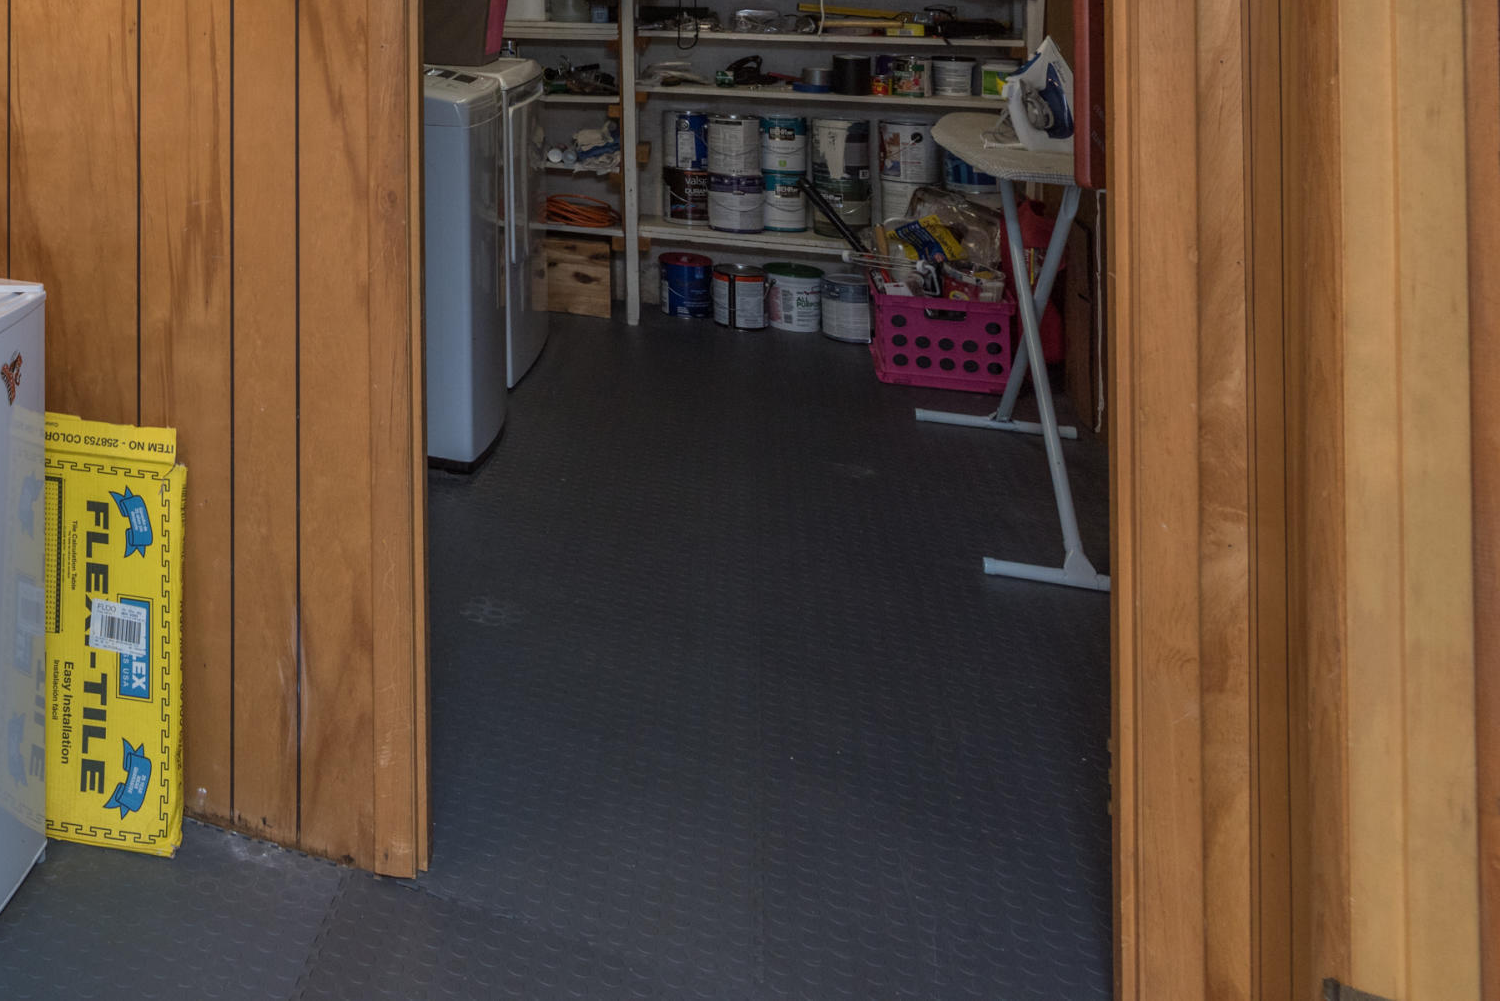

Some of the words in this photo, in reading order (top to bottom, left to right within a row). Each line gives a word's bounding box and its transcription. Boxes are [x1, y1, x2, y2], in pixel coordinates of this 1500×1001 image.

[45, 431, 81, 444] COLOR
[84, 436, 119, 447] 258753
[128, 440, 145, 450] NO
[148, 442, 174, 454] ITEM
[62, 660, 75, 691] Easy
[60, 694, 74, 765] Installation
